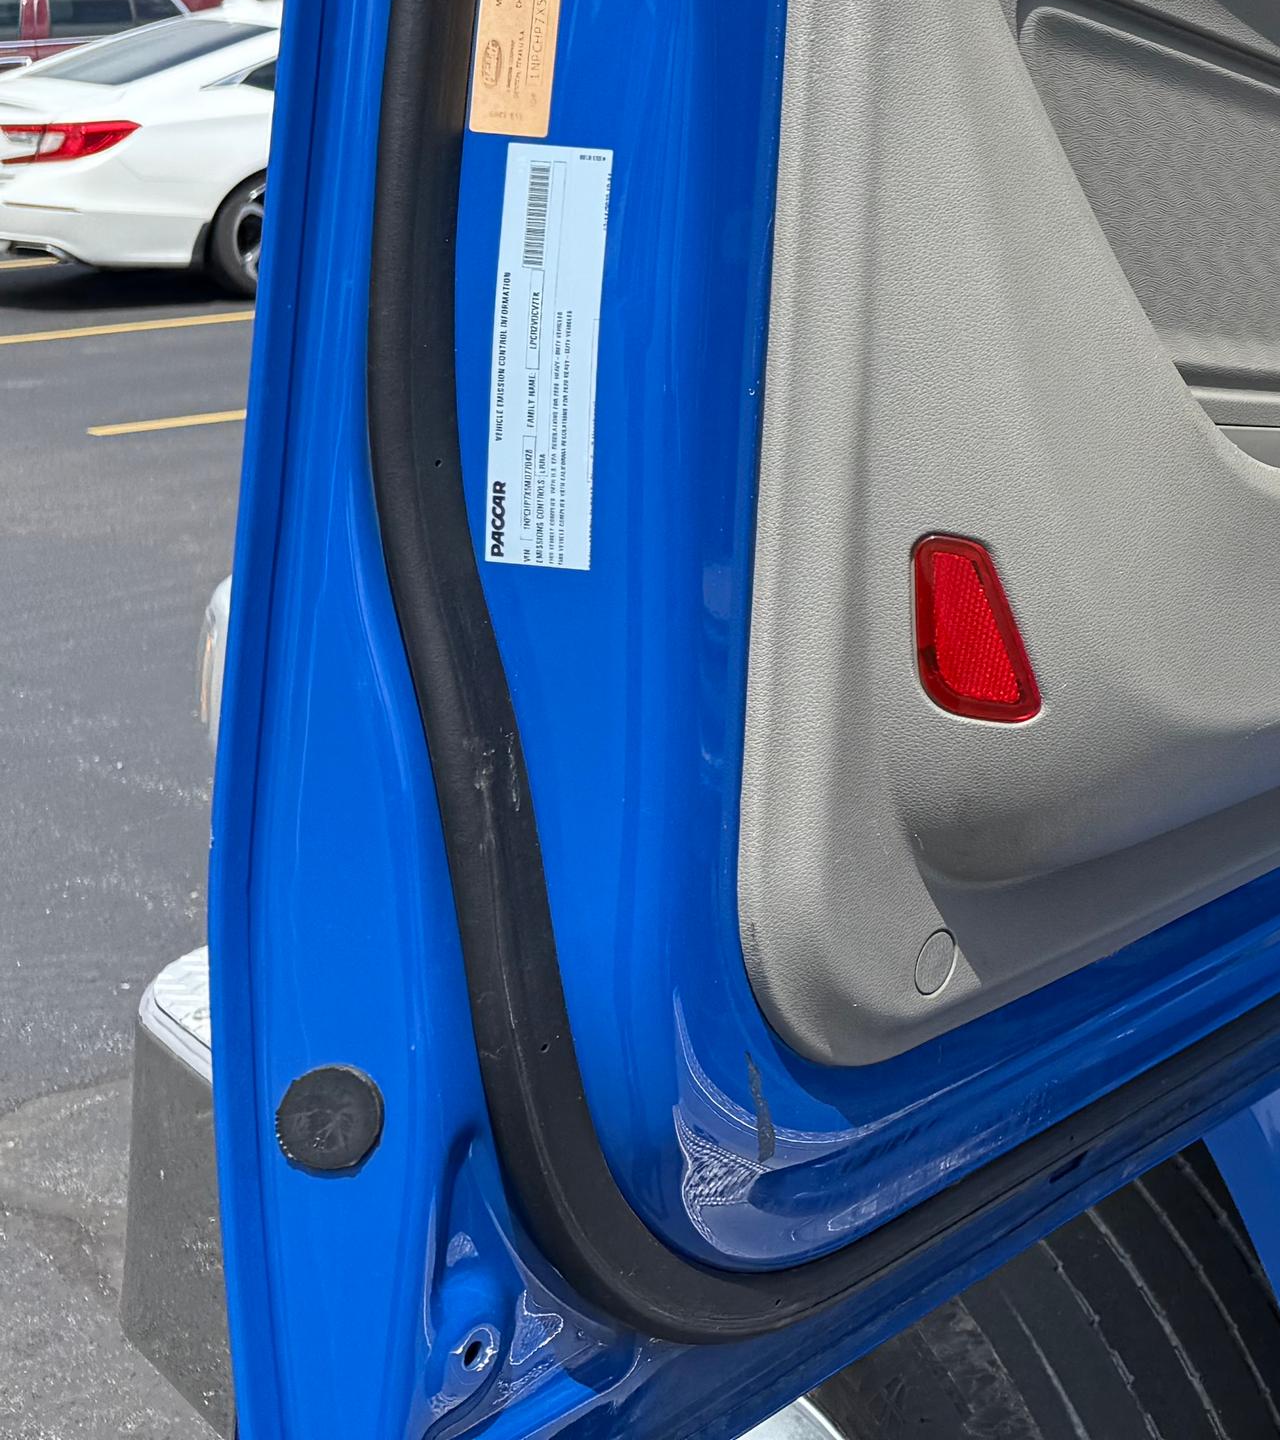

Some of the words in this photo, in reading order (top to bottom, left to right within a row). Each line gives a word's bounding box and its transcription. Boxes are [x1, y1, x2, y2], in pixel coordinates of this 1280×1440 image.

[499, 272, 511, 328] INFORMATION
[497, 329, 508, 366] CONTROL
[496, 368, 506, 407] EMISSION
[495, 409, 504, 442] VEHICLE
[526, 399, 535, 429] FAMILY
[490, 480, 506, 558] PACCAR
[535, 522, 544, 564] EMISSIONS
